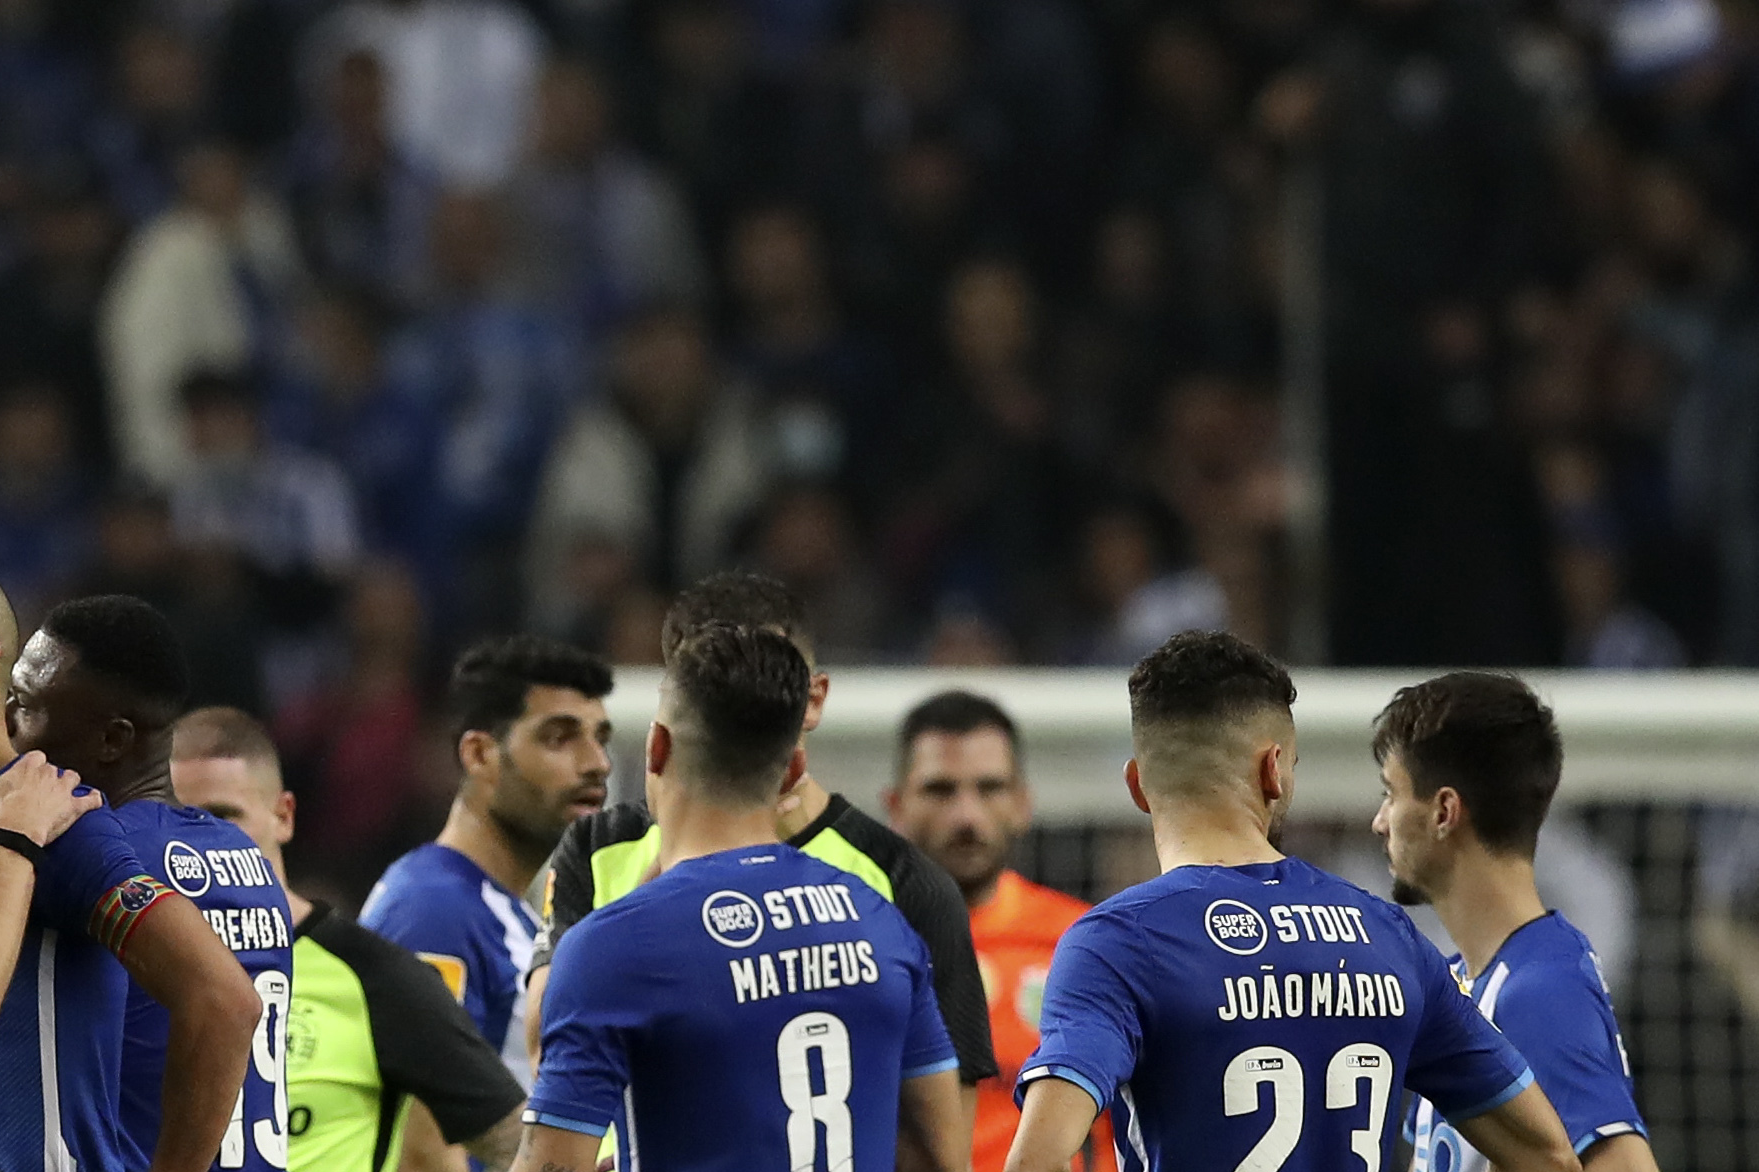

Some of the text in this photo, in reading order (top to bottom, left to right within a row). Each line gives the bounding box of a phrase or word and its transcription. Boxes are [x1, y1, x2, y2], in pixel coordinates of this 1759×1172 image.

[175, 866, 205, 880] BOCK
[205, 847, 273, 887] STOUT
[716, 915, 756, 934] BOCK
[763, 884, 860, 930] STOUT
[1212, 914, 1256, 928] SUPER
[1270, 904, 1370, 944] STOUT
[202, 906, 289, 951] BEMBA
[1218, 926, 1259, 939] BOCK
[729, 940, 880, 1004] MATHEUS
[1218, 958, 1406, 1021] JOÃO MÁRIO
